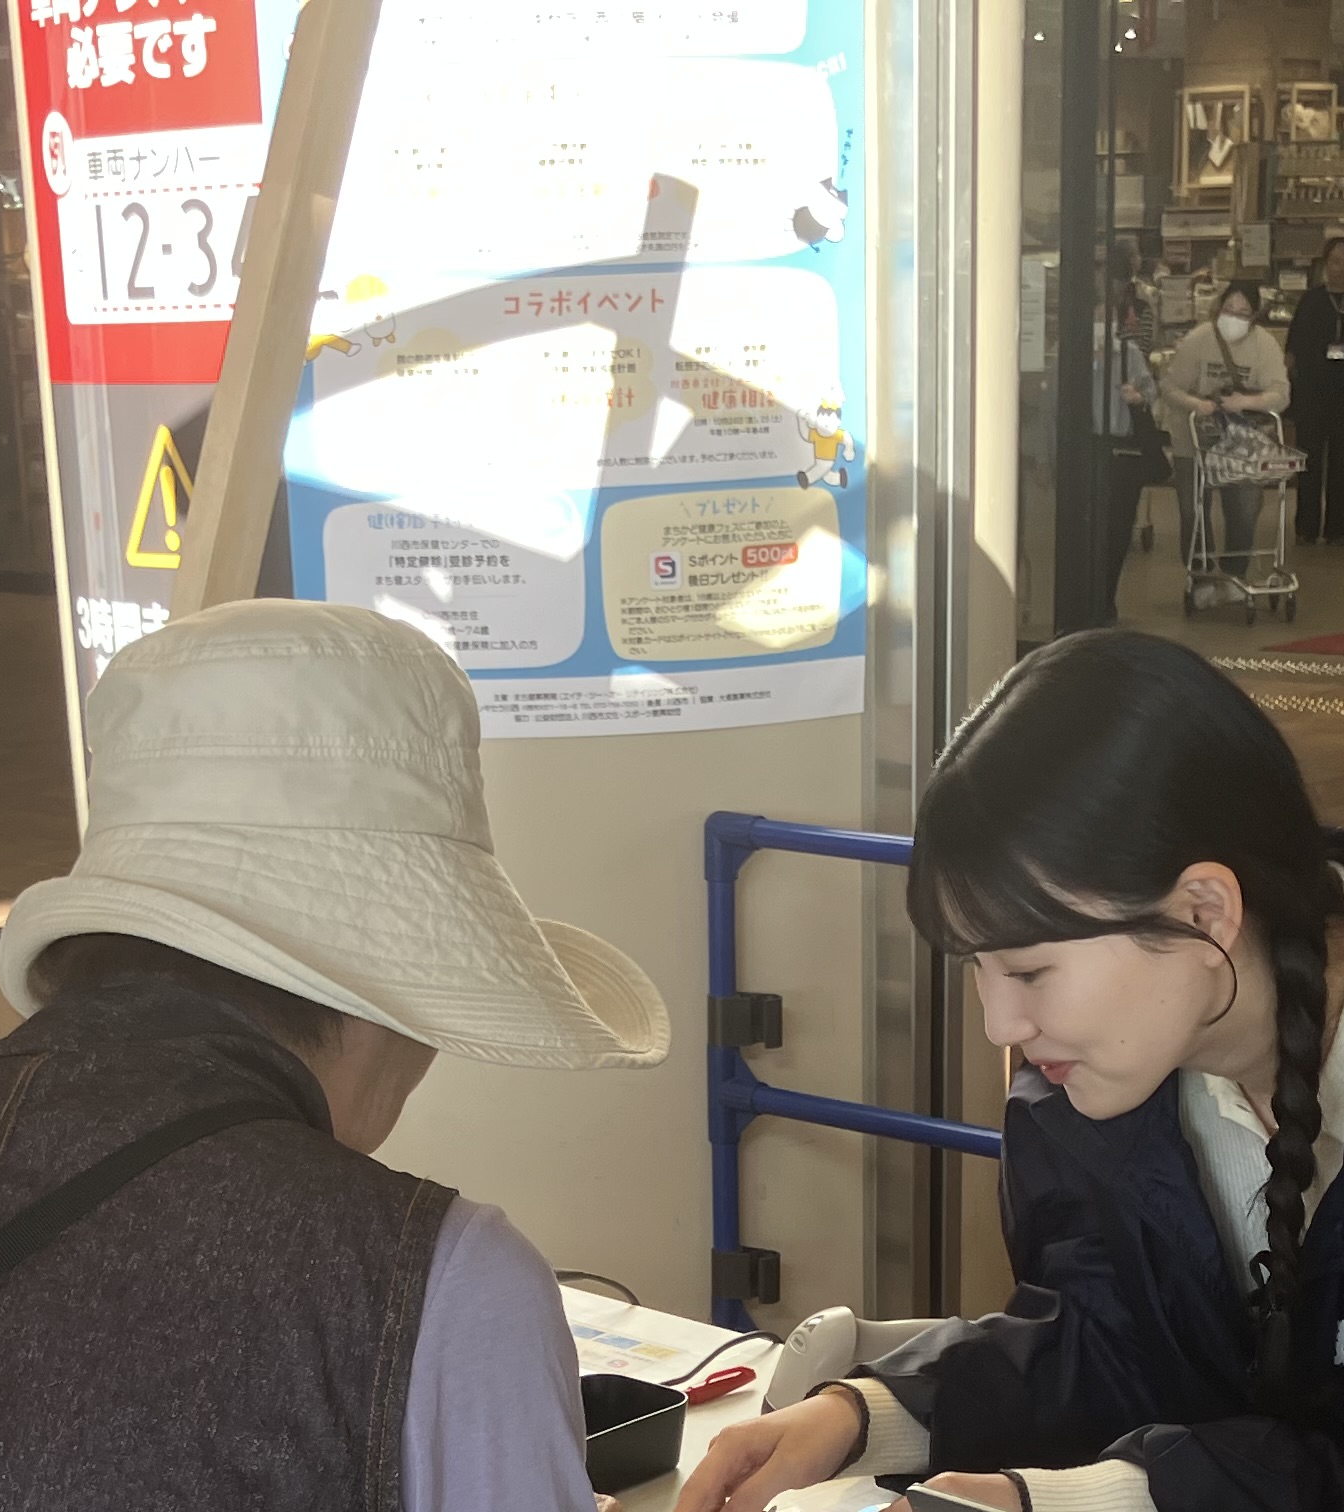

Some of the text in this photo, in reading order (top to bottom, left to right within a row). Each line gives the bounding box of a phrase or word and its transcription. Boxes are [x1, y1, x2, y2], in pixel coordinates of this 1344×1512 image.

[67, 13, 217, 88] 必要です
[503, 287, 665, 316] コラボイベント
[697, 497, 760, 516] プレゼント
[688, 554, 739, 568] Sポイント
